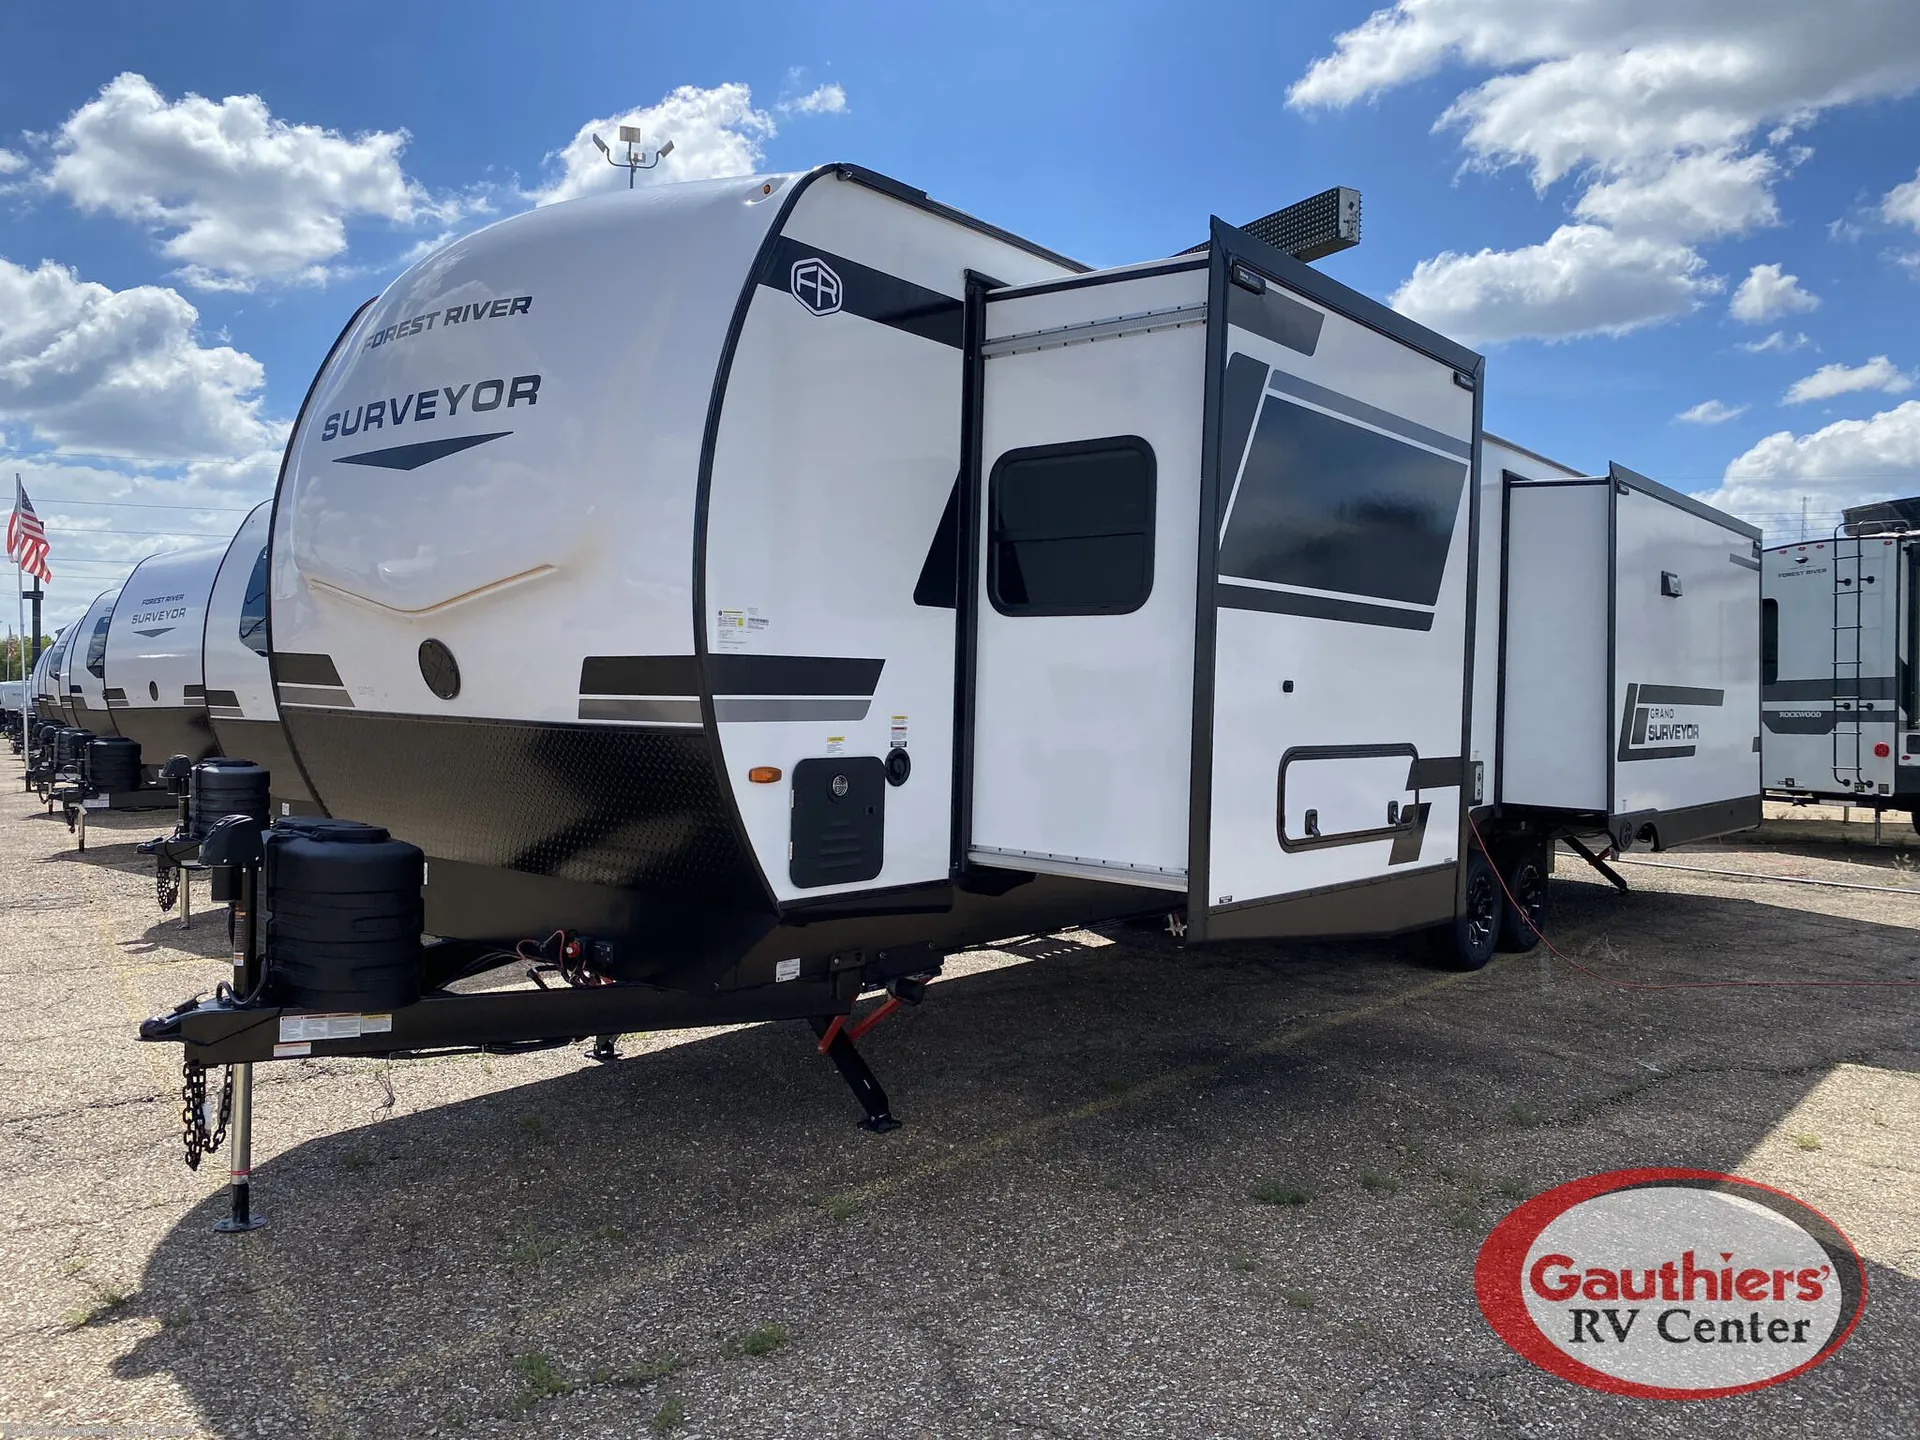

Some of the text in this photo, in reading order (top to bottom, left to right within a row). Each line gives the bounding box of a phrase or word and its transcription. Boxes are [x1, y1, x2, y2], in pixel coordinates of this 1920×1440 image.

[361, 295, 533, 353] FOREST RIVER
[321, 374, 542, 442] SURVEYOR
[141, 593, 185, 606] FOREST RIVER
[131, 607, 187, 624] SURVEYOR
[1649, 708, 1674, 719] GRAND
[1648, 723, 1700, 741] SURVEYOR
